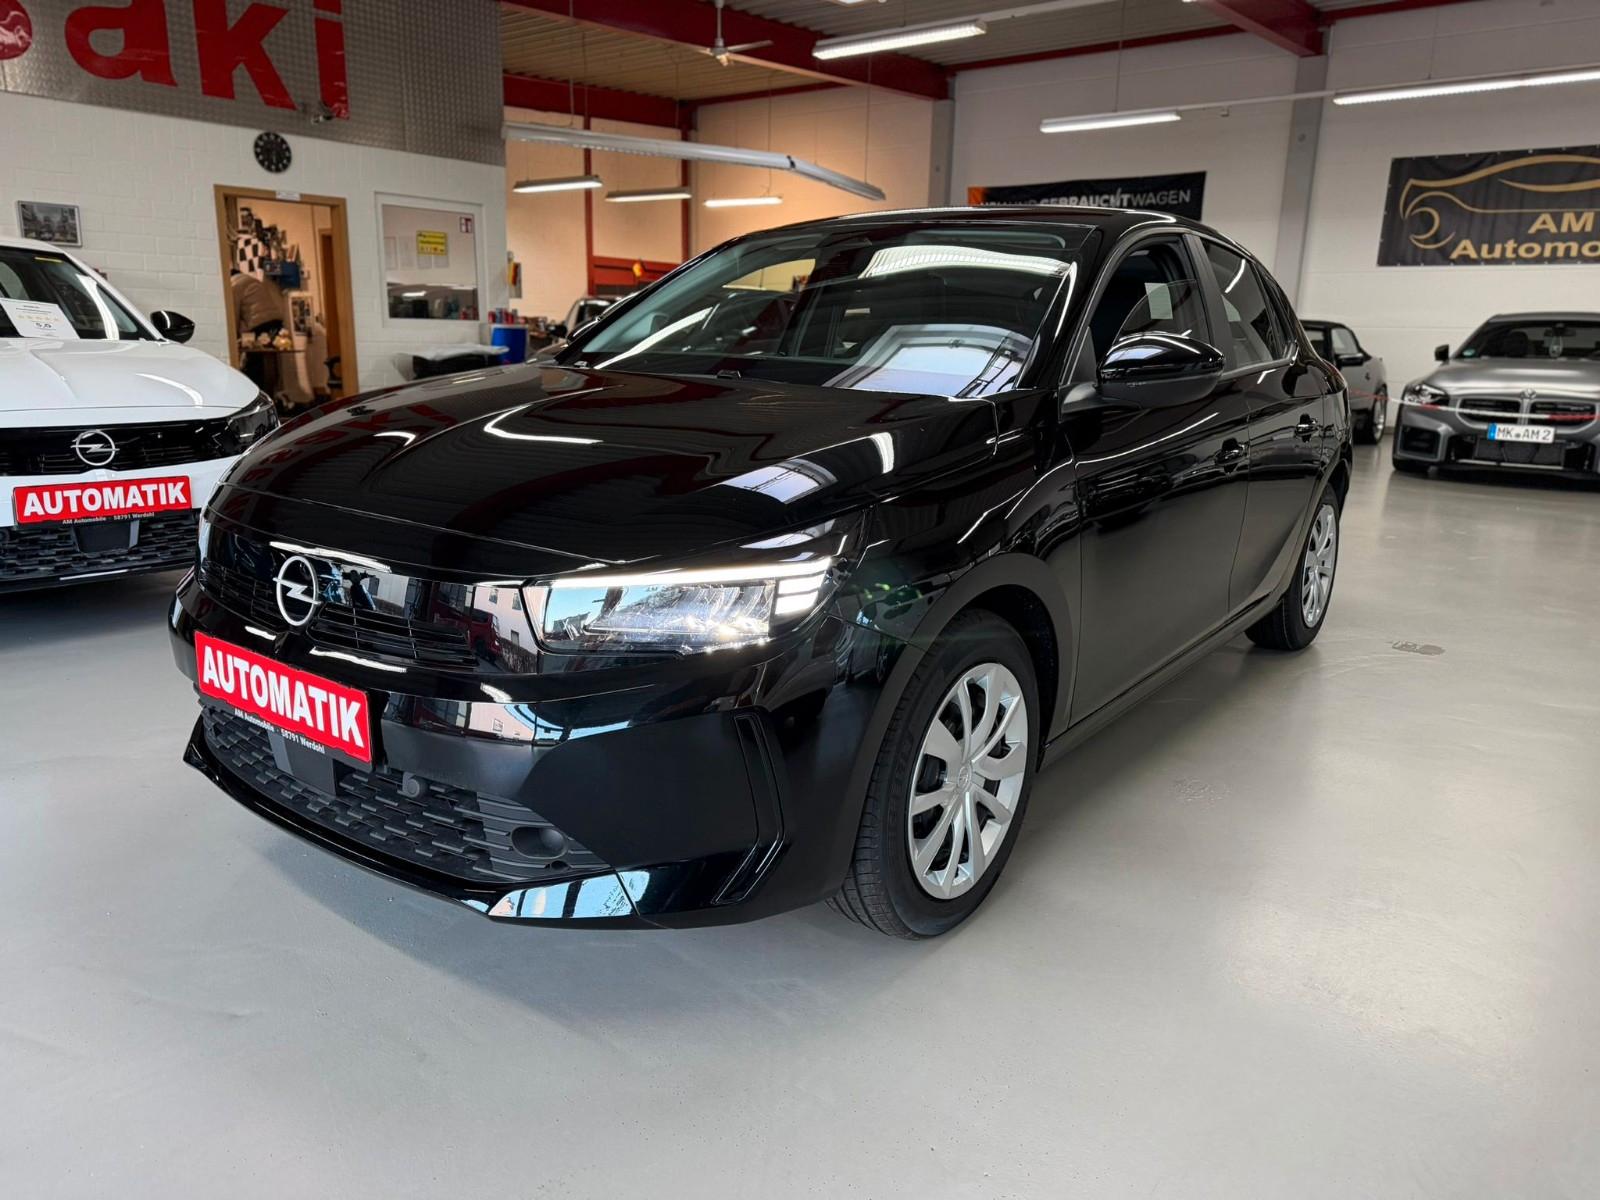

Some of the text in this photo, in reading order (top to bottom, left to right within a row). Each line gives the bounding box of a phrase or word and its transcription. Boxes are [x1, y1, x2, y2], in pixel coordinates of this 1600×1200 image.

[1527, 211, 1595, 234] AM
[1497, 427, 1514, 438] MK
[24, 482, 187, 516] AUTOMATIK
[203, 645, 364, 748] AUTOMATIK
[280, 728, 299, 743] 58791
[300, 733, 326, 755] Werdohl
